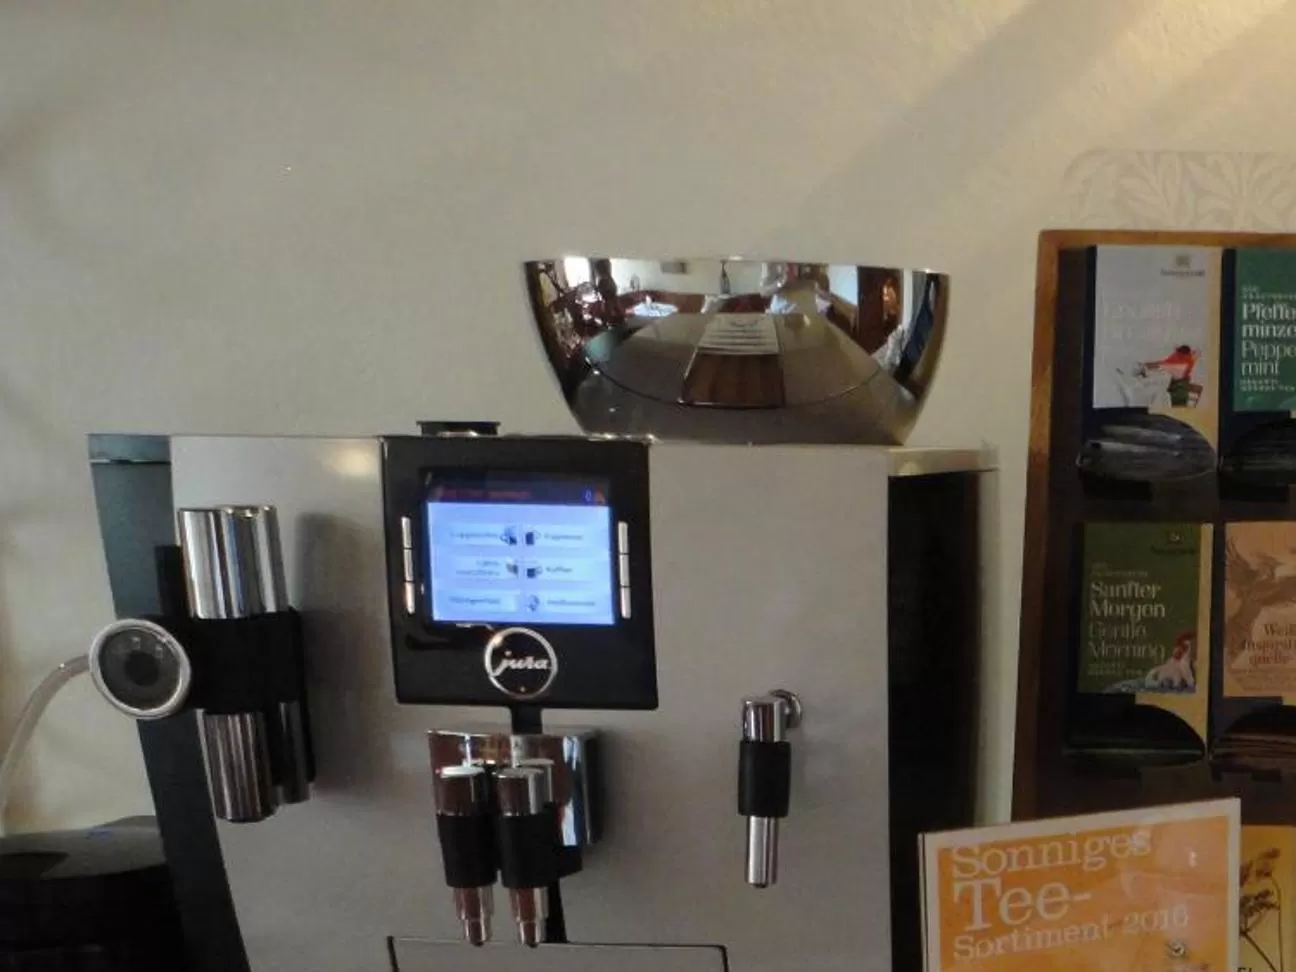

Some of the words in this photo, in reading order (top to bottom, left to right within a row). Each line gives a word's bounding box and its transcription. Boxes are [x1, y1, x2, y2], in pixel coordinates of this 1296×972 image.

[1241, 358, 1281, 376] mint
[1089, 599, 1166, 621] Morgen
[491, 650, 549, 677] jura
[951, 828, 1151, 878] Sonniges
[952, 876, 1092, 932] Tee-
[953, 913, 1112, 961] Sortiment
